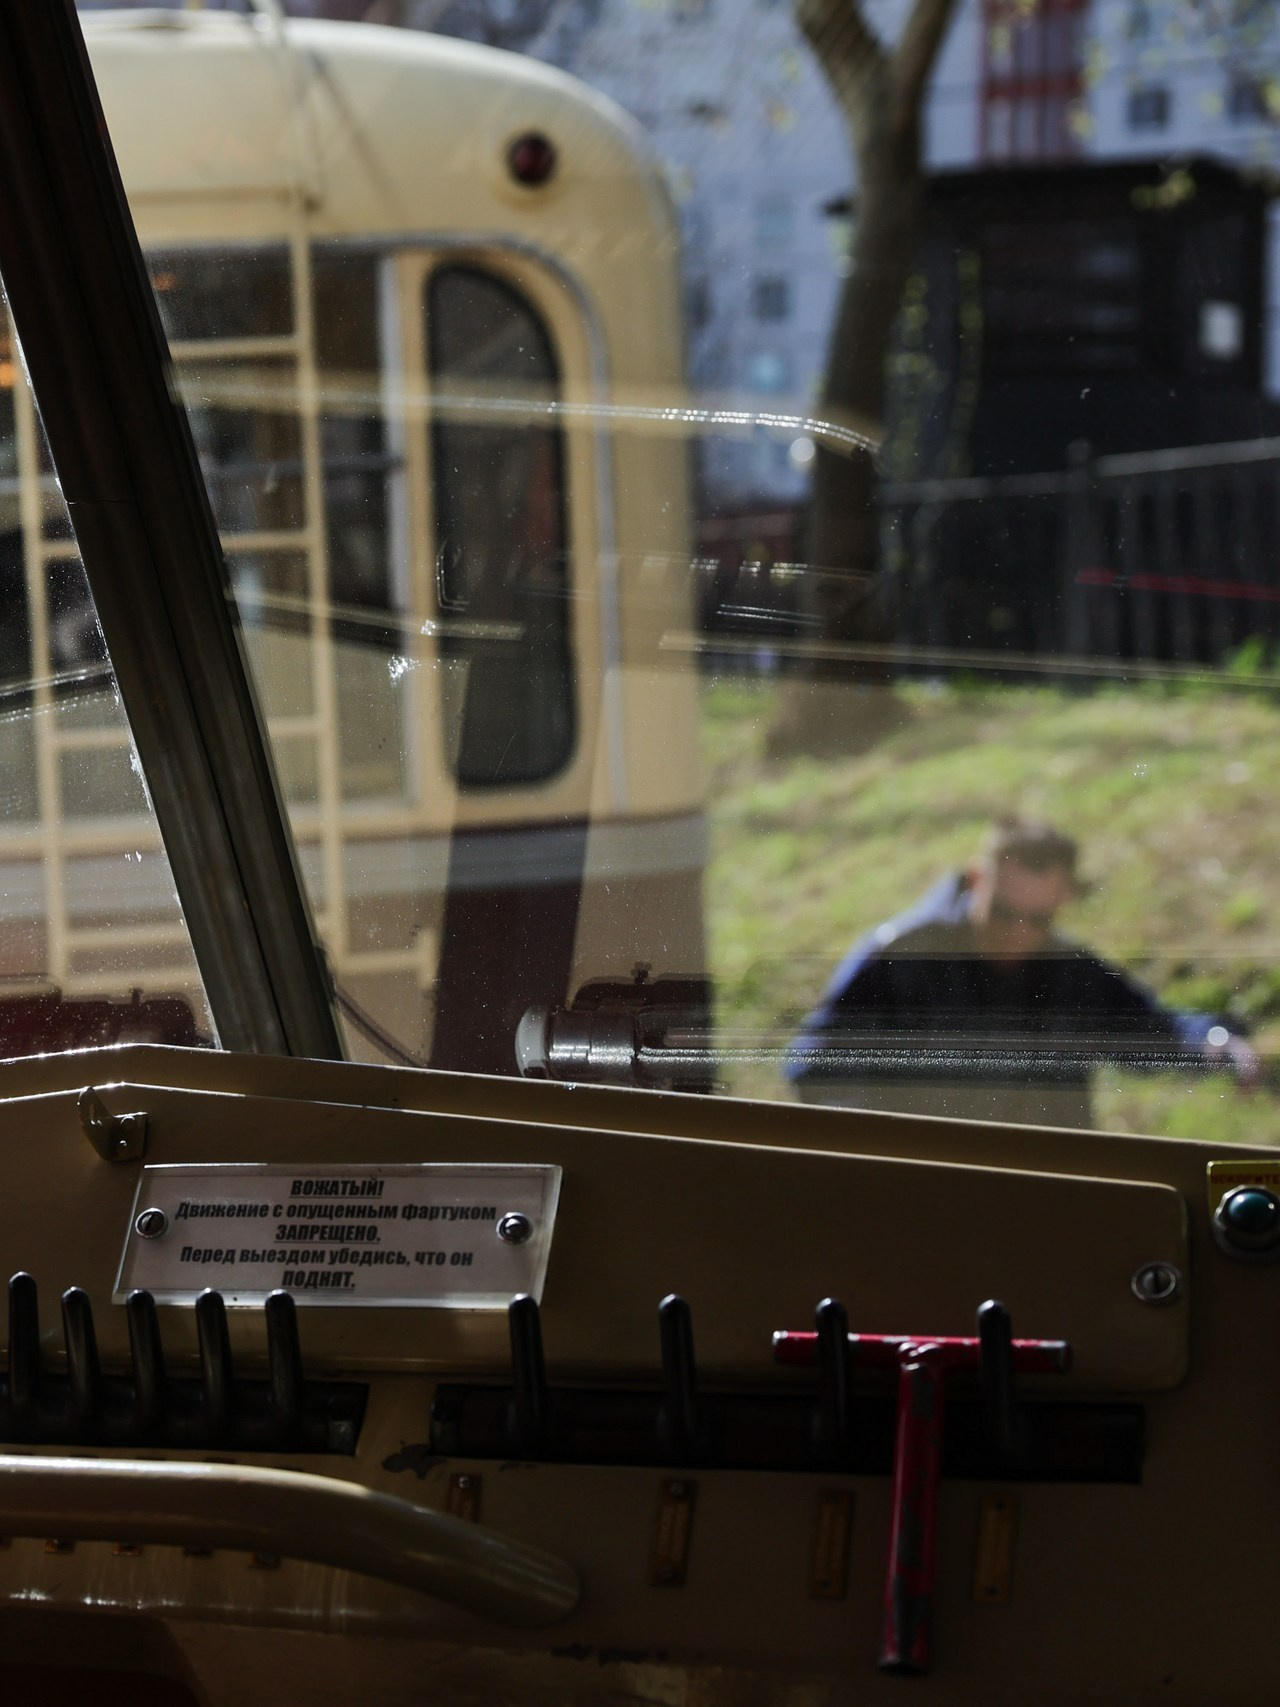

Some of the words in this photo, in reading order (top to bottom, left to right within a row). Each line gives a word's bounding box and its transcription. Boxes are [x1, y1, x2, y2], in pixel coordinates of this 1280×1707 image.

[291, 1178, 384, 1196] ВОЖАТЫЙ!
[175, 1202, 269, 1220] Движение
[273, 1204, 283, 1218] с
[287, 1204, 398, 1220] опущенным
[401, 1203, 496, 1221] фартуком
[275, 1224, 380, 1243] ЗАПРЕЩЕНО.
[180, 1246, 236, 1264] Перед
[239, 1249, 325, 1265] выездом
[328, 1248, 410, 1267] убедись,
[415, 1251, 445, 1265] что
[450, 1252, 473, 1266] он
[282, 1270, 355, 1288] ПОДНЯТ.
